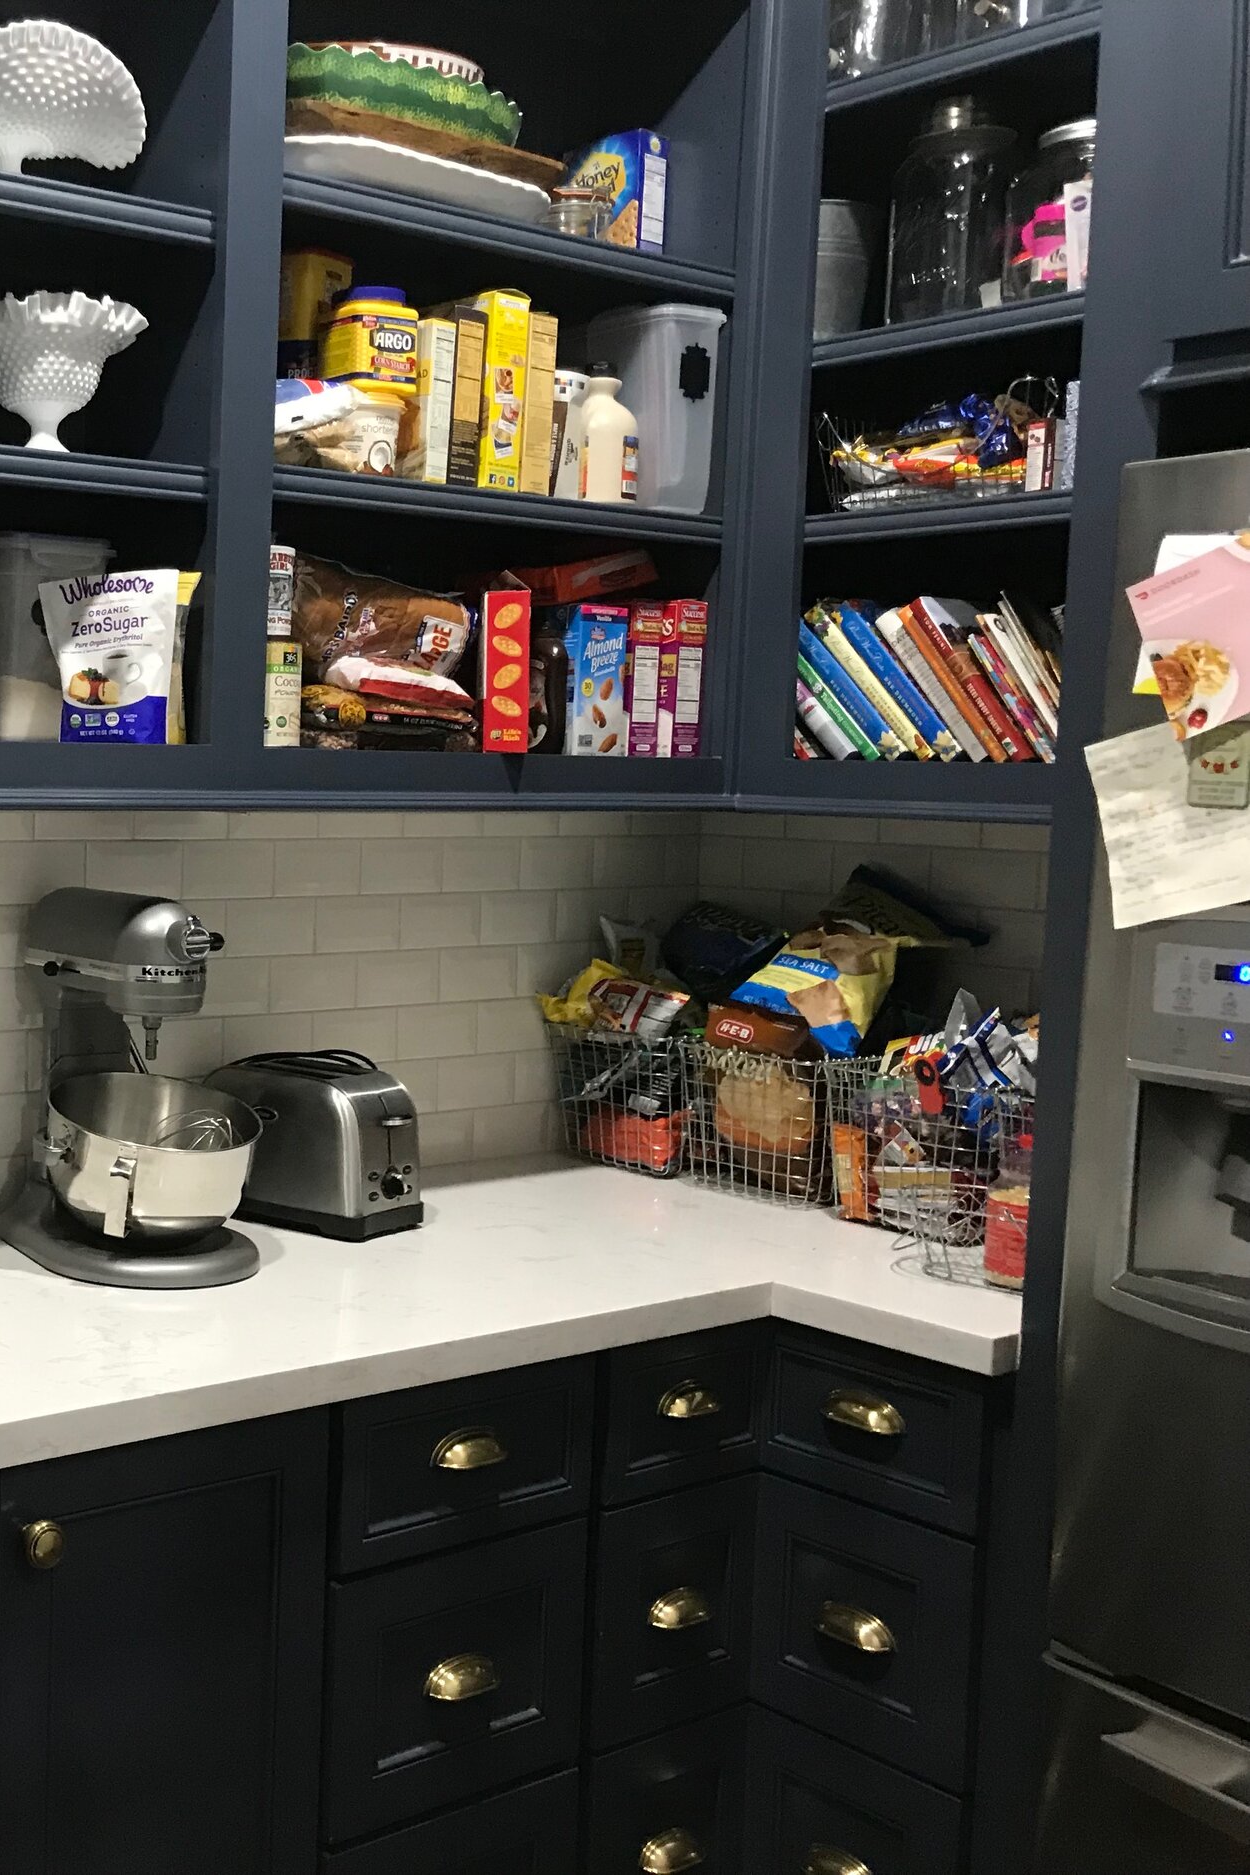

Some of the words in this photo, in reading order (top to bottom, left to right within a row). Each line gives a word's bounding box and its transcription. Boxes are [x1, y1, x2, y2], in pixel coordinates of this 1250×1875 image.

[374, 332, 412, 351] ARGO
[87, 605, 131, 618] ORGANIC
[682, 607, 705, 619] Success
[70, 615, 149, 638] ZeroSugar
[582, 632, 624, 661] Almond
[285, 652, 297, 663] 365
[590, 651, 619, 674] Breeze
[778, 955, 798, 968] SEA
[799, 960, 831, 975] SALT
